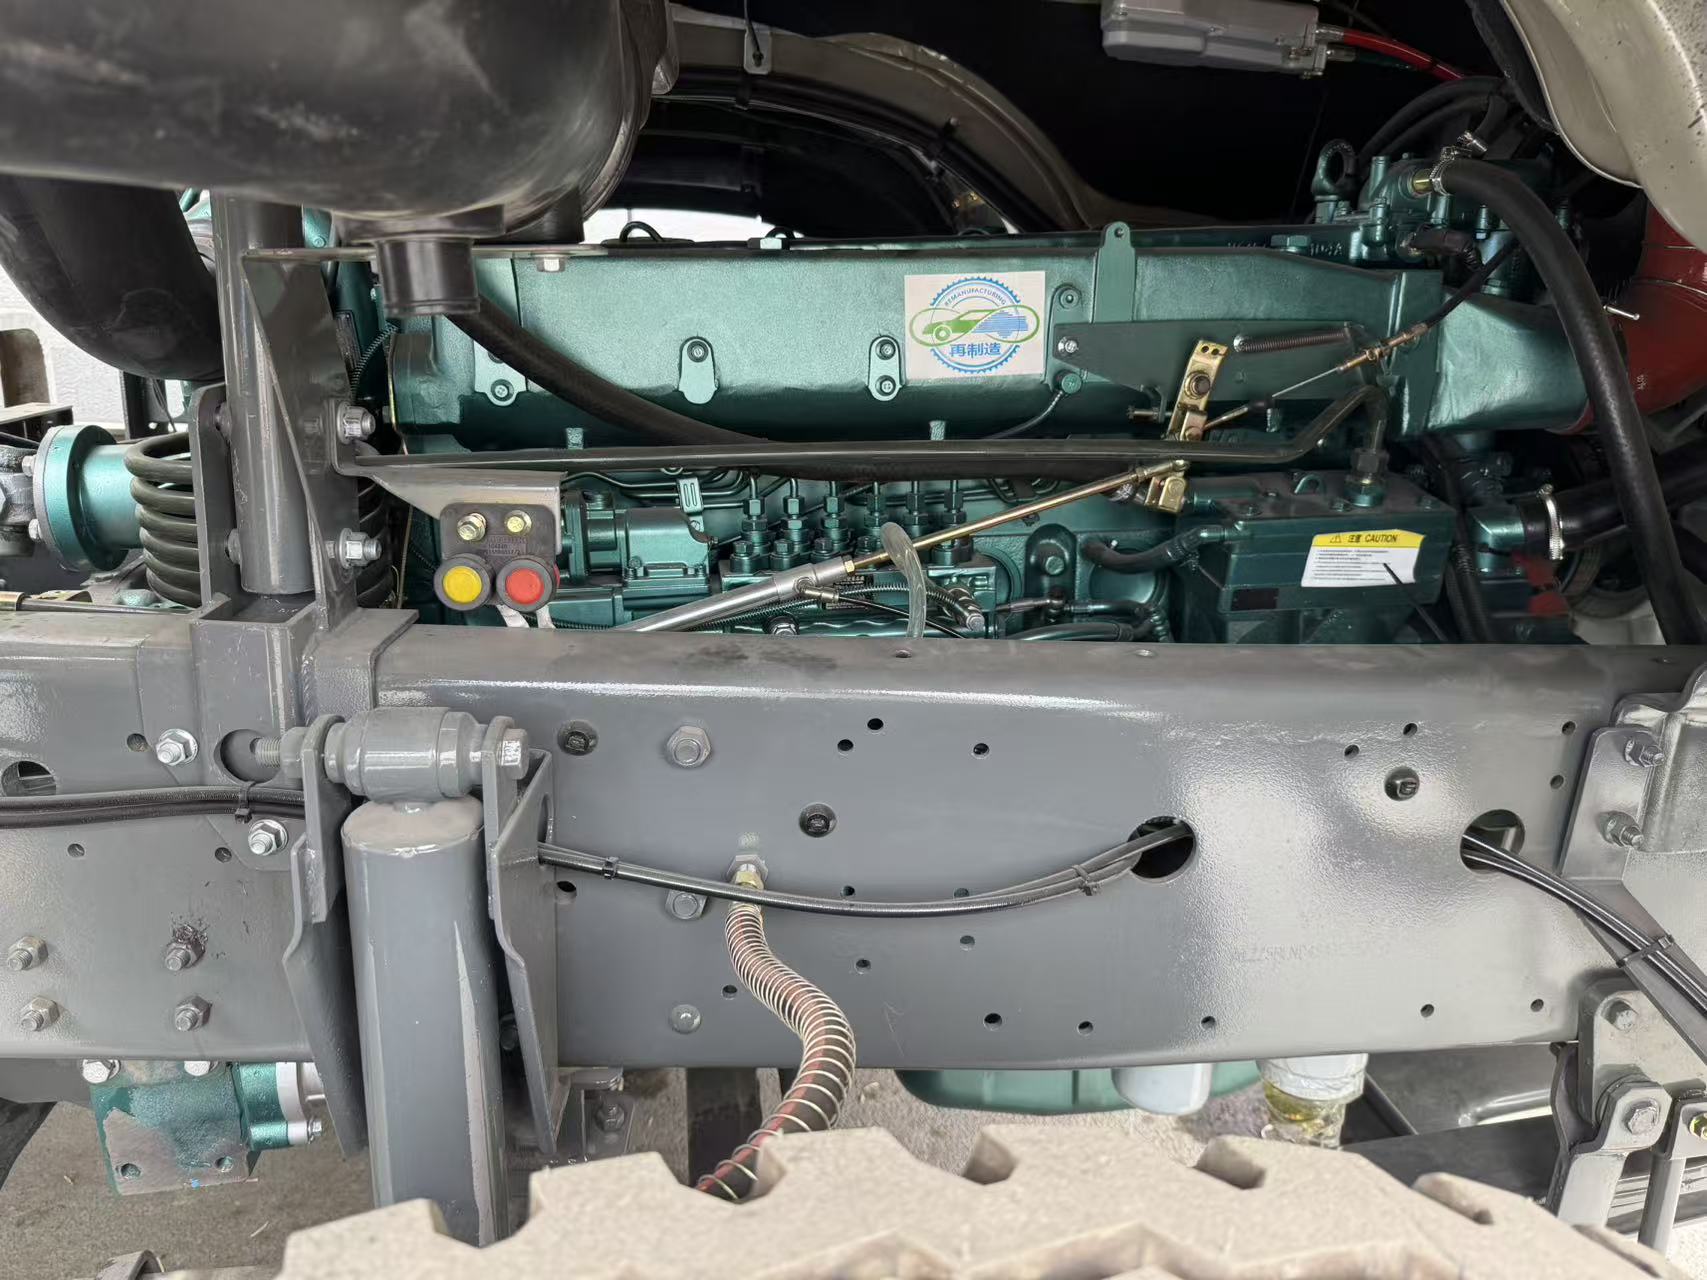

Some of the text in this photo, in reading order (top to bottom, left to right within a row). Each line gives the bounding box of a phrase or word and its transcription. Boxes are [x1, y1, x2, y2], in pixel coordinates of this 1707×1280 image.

[944, 287, 1007, 307] REMANUFACTURING
[949, 342, 1002, 359] 再制造
[1365, 533, 1398, 543] CAUTION
